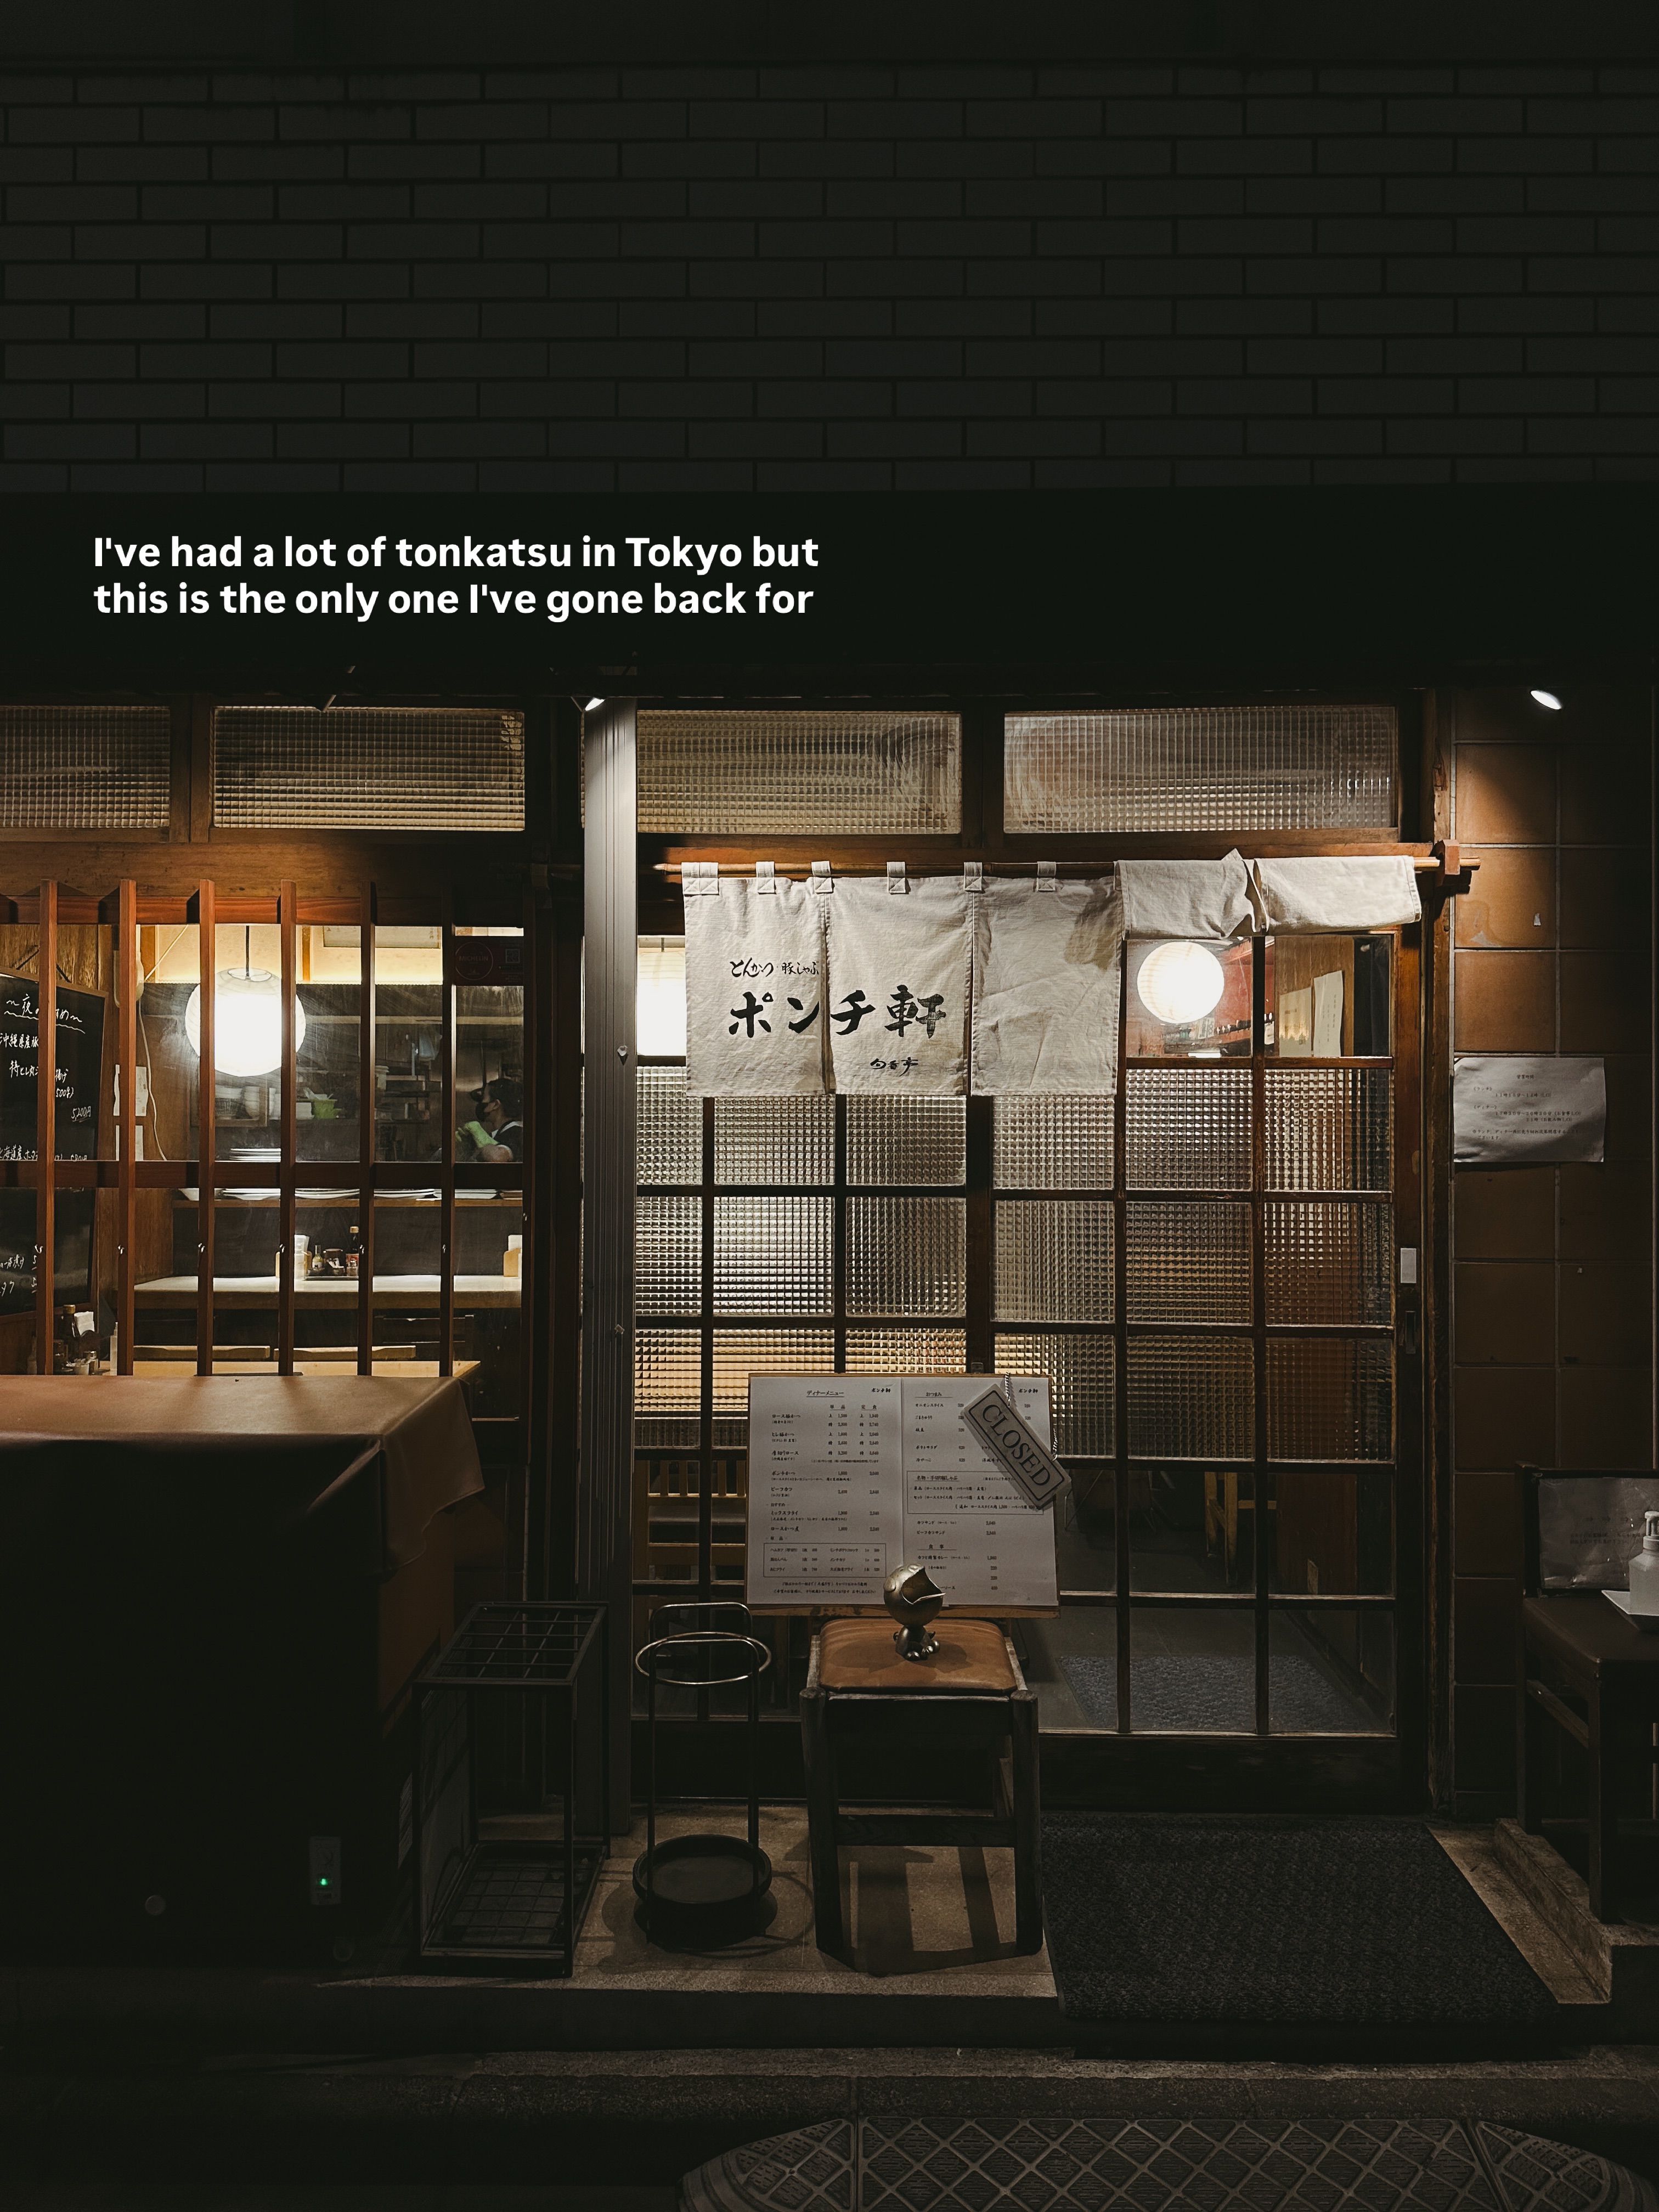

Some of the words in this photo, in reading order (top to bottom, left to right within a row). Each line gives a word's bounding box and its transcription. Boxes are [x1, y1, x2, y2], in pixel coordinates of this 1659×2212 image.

[729, 984, 946, 1039] ポンチ軒
[982, 1404, 1051, 1487] CLOSED
